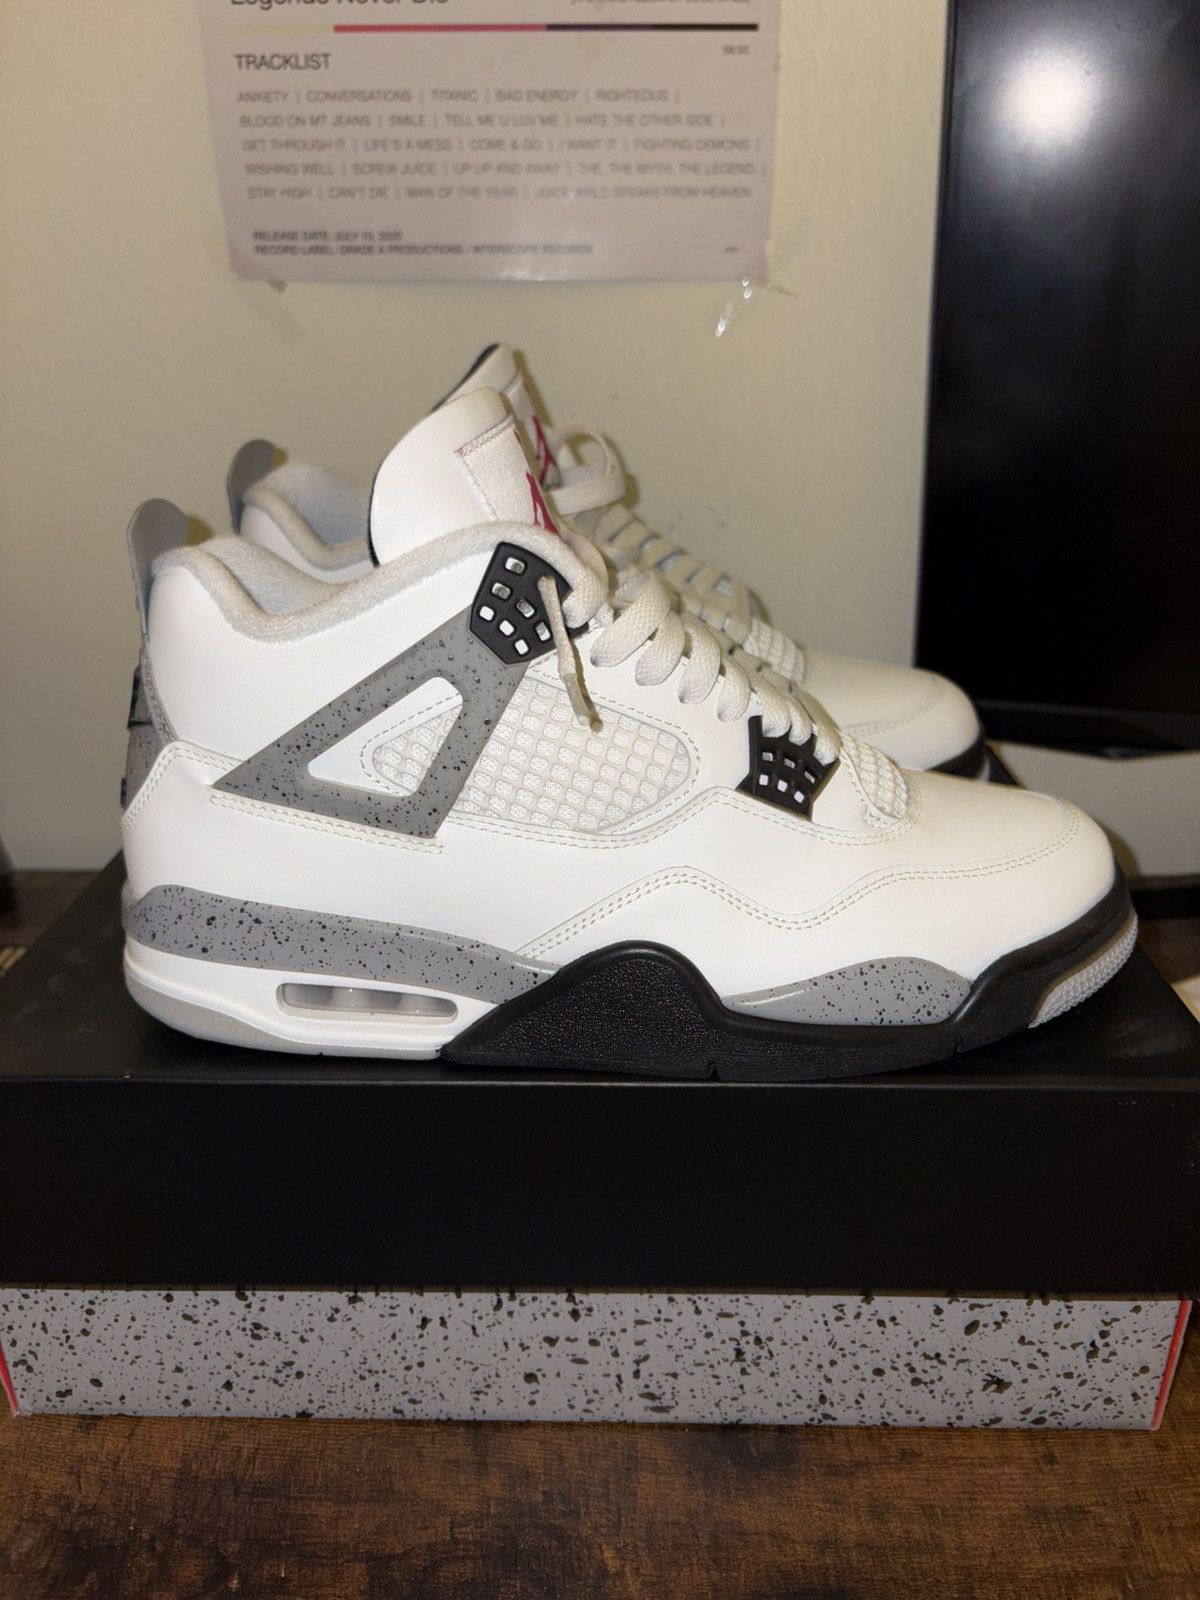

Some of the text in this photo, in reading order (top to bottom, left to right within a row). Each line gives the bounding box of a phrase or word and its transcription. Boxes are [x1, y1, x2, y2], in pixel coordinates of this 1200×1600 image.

[234, 54, 331, 70] TRACKLIST
[238, 88, 669, 103] ANXIETY CONVERSATIONS TITANIC BAD ENERGY RIGHTEOUS
[239, 114, 284, 128] BLOOD
[286, 114, 306, 128] ON
[331, 114, 371, 128] JEANS
[388, 114, 425, 127] SMILE
[444, 114, 473, 127] TELL
[476, 114, 495, 127] ME
[497, 113, 509, 127] U
[539, 113, 558, 127] ME
[576, 113, 607, 127] HATE
[612, 113, 635, 126] THE
[638, 113, 681, 126] OTHER
[684, 113, 712, 126] SIDE
[242, 139, 266, 152] GET
[270, 139, 332, 152] THROUGH
[403, 139, 413, 152] A
[415, 139, 451, 152] MESS
[468, 139, 505, 152] COME
[521, 138, 543, 151] GO
[633, 138, 691, 151] FIGHTING
[694, 138, 750, 151] DEMONS
[245, 163, 298, 176] WISHING
[301, 163, 335, 176] WELL
[351, 163, 398, 176] SCREW
[399, 163, 436, 176] JUICE
[452, 163, 470, 176] UP
[474, 163, 492, 176] UP
[678, 162, 701, 175] THE
[704, 162, 756, 175] LEGEND
[247, 186, 276, 200] STAY
[280, 186, 312, 200] HIGH
[368, 186, 387, 200] DIE
[436, 186, 453, 200] OF
[456, 186, 480, 200] THE
[484, 186, 517, 199] YEAR
[701, 186, 751, 199] HEAVEN
